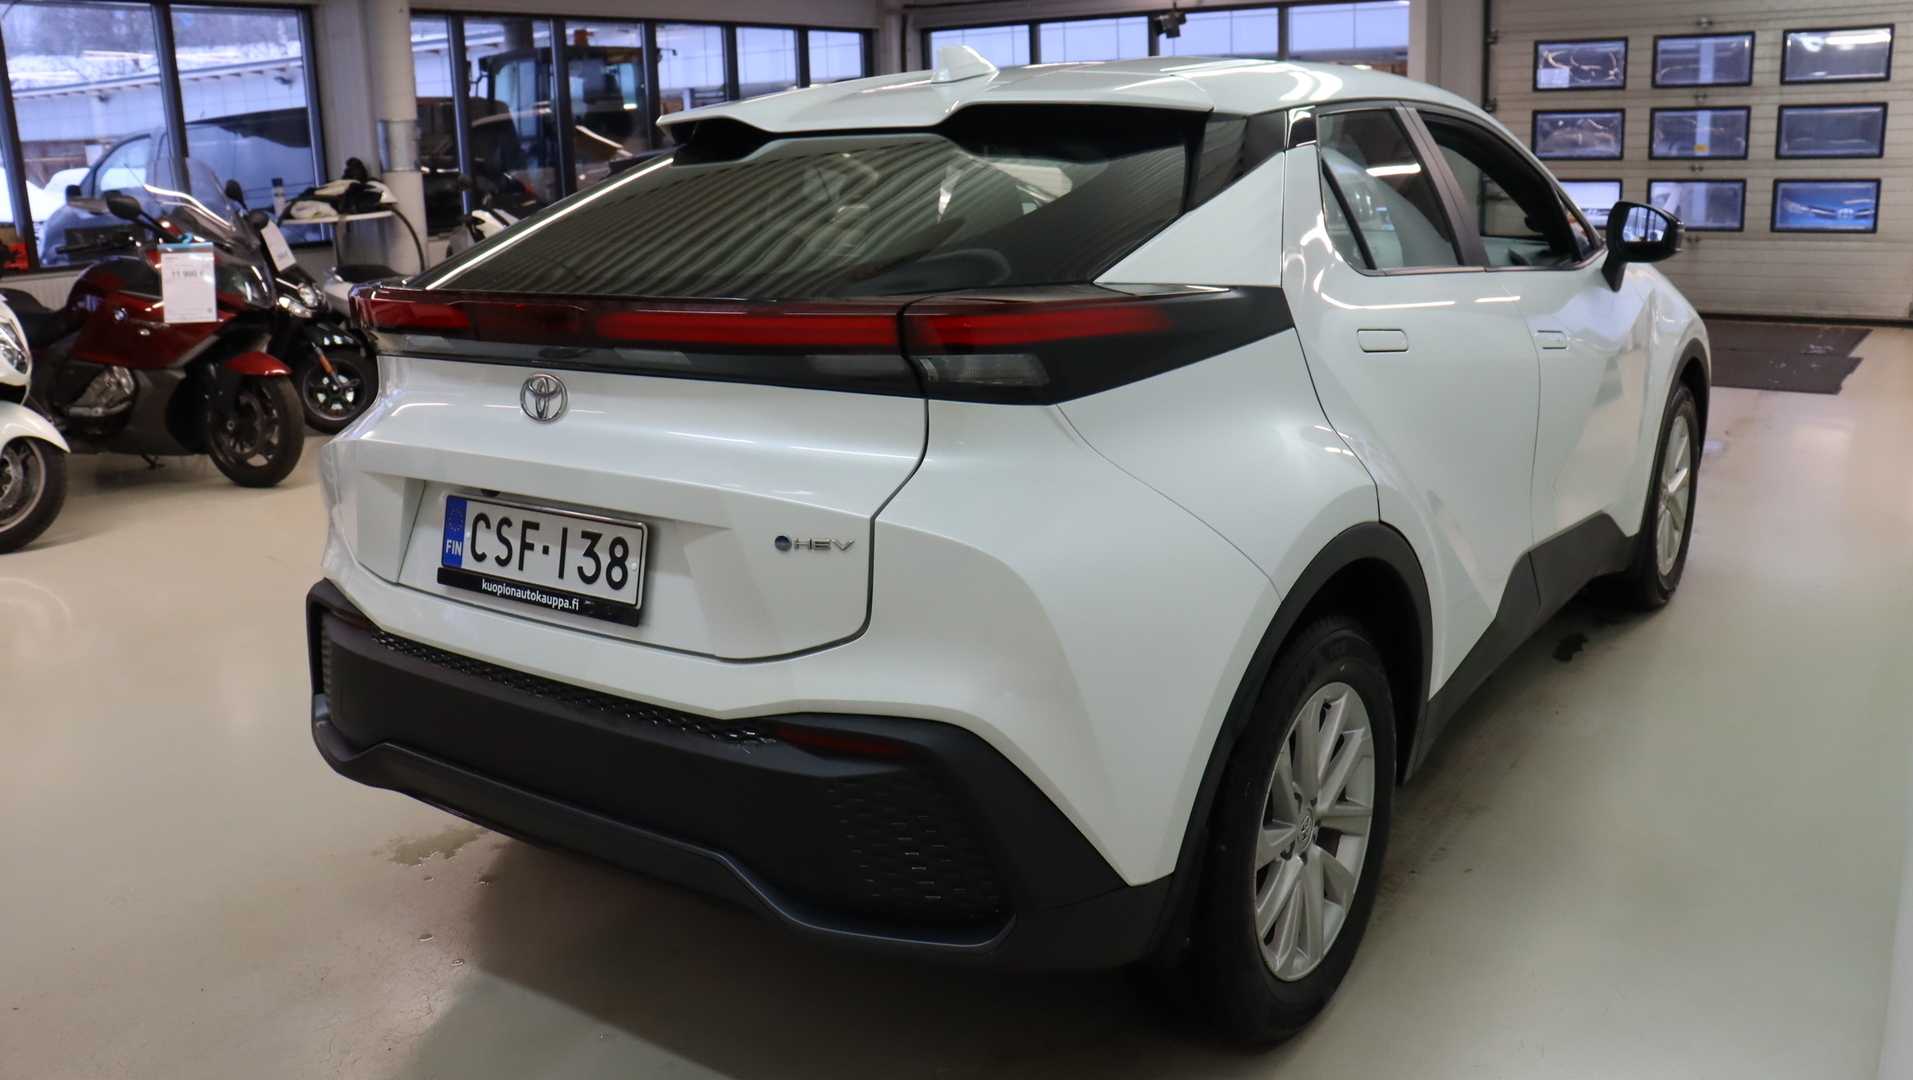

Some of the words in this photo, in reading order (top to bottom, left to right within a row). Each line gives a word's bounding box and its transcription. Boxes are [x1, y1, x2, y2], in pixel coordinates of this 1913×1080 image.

[171, 270, 180, 278] 11
[183, 269, 198, 278] 900
[445, 539, 463, 556] FIN
[470, 512, 630, 591] CSF-138
[793, 538, 855, 552] HEV
[481, 578, 580, 611] kuopionautokauppa.fi
